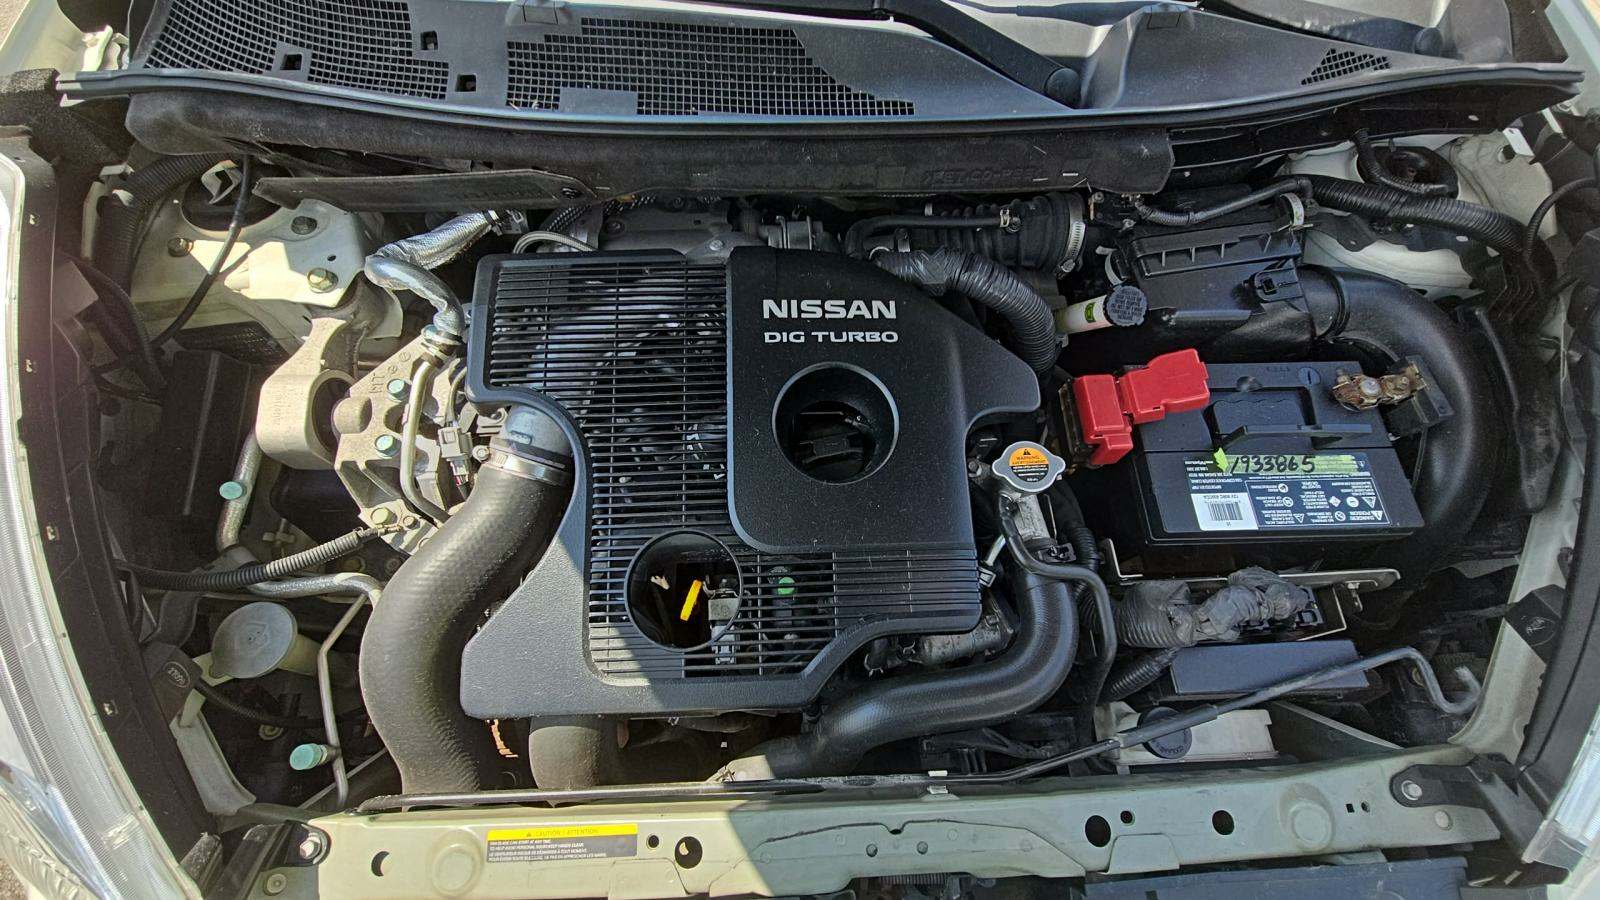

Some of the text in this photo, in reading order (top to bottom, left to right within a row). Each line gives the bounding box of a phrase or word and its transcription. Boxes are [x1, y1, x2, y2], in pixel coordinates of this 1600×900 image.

[762, 299, 897, 319] NISSAN
[764, 331, 899, 343] DIG TURBO
[1230, 454, 1317, 474] 1933865
